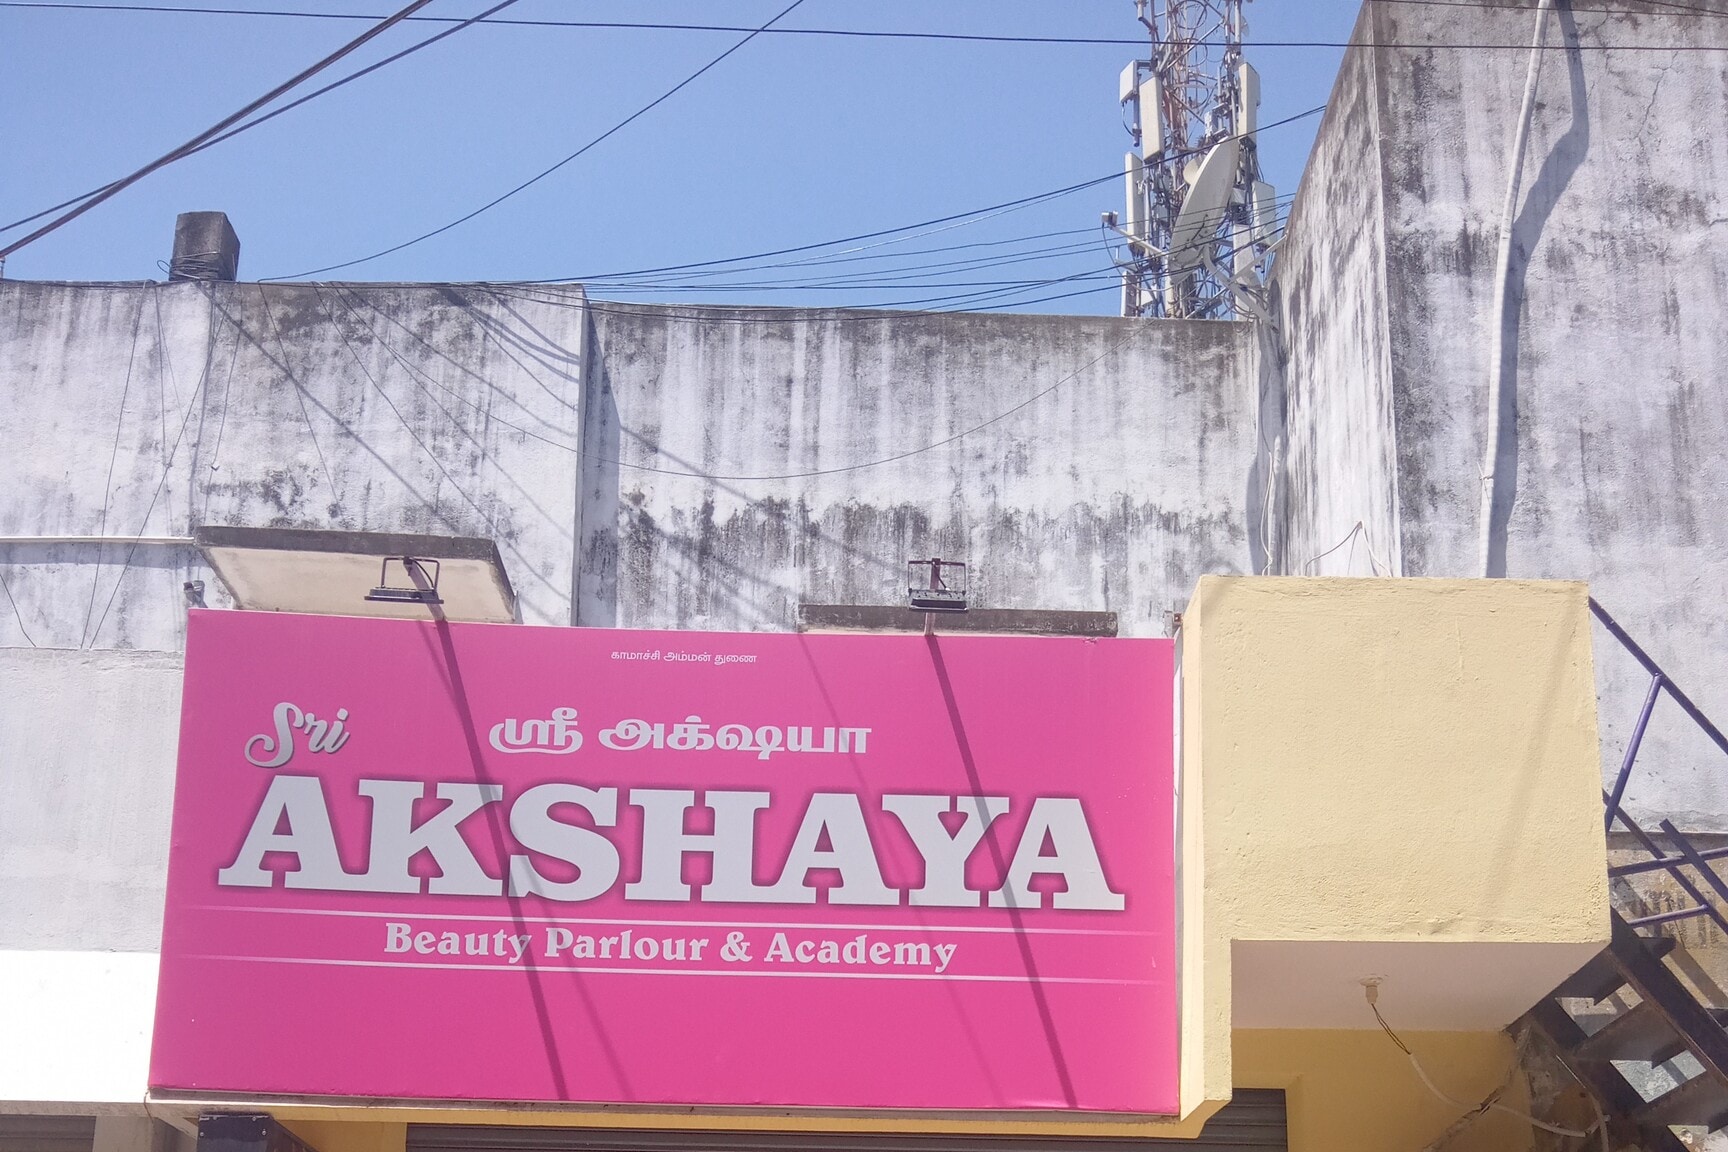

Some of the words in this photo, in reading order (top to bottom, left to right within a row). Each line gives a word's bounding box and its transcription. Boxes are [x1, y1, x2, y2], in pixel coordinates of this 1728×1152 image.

[611, 650, 660, 660] காமாச்சி
[664, 651, 711, 662] அம்மன்
[714, 653, 757, 665] துணை
[244, 702, 351, 768] Sri
[598, 715, 872, 759] அக்ஷயா
[217, 775, 1126, 911] AKSHAYA
[384, 922, 530, 963] Beauty
[545, 927, 708, 961] Parlour
[720, 932, 752, 962] &
[764, 933, 958, 974] Academy
